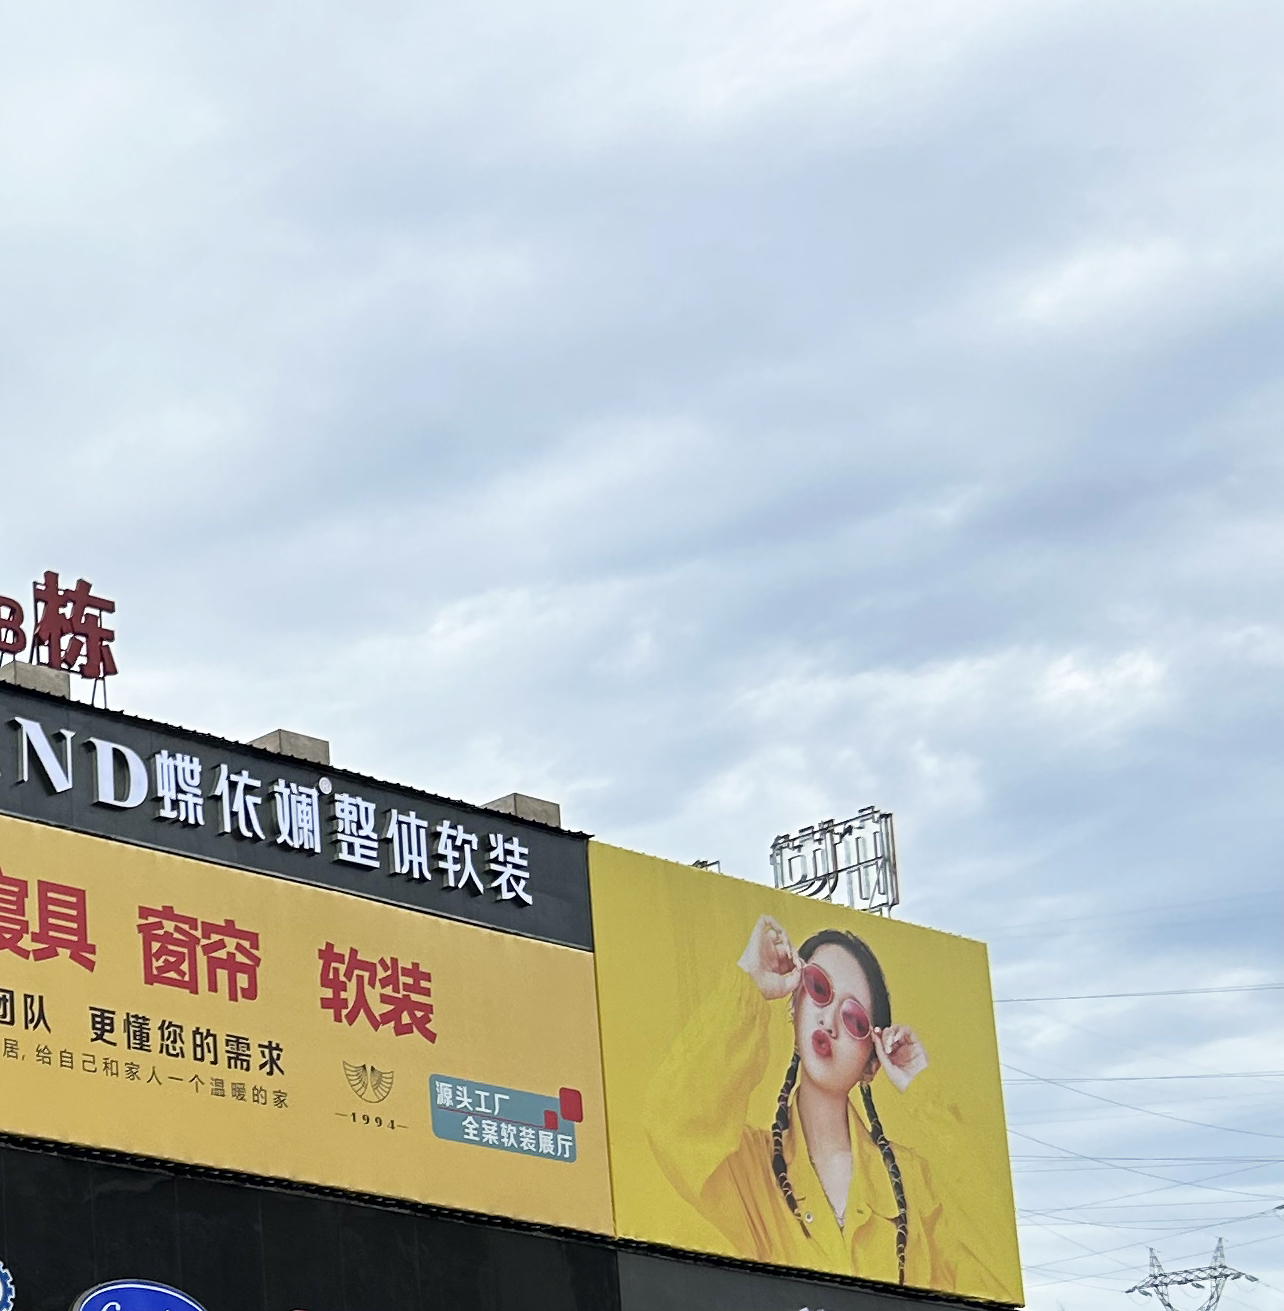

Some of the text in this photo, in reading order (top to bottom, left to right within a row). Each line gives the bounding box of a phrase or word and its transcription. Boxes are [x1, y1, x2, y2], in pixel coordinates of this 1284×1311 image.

[137, 904, 261, 1003] 窗帘
[318, 942, 437, 1043] 软装
[88, 1005, 286, 1077] 更懂您的需求
[435, 1079, 510, 1116] 源头工厂
[461, 1115, 574, 1159] 全案软装展厅
